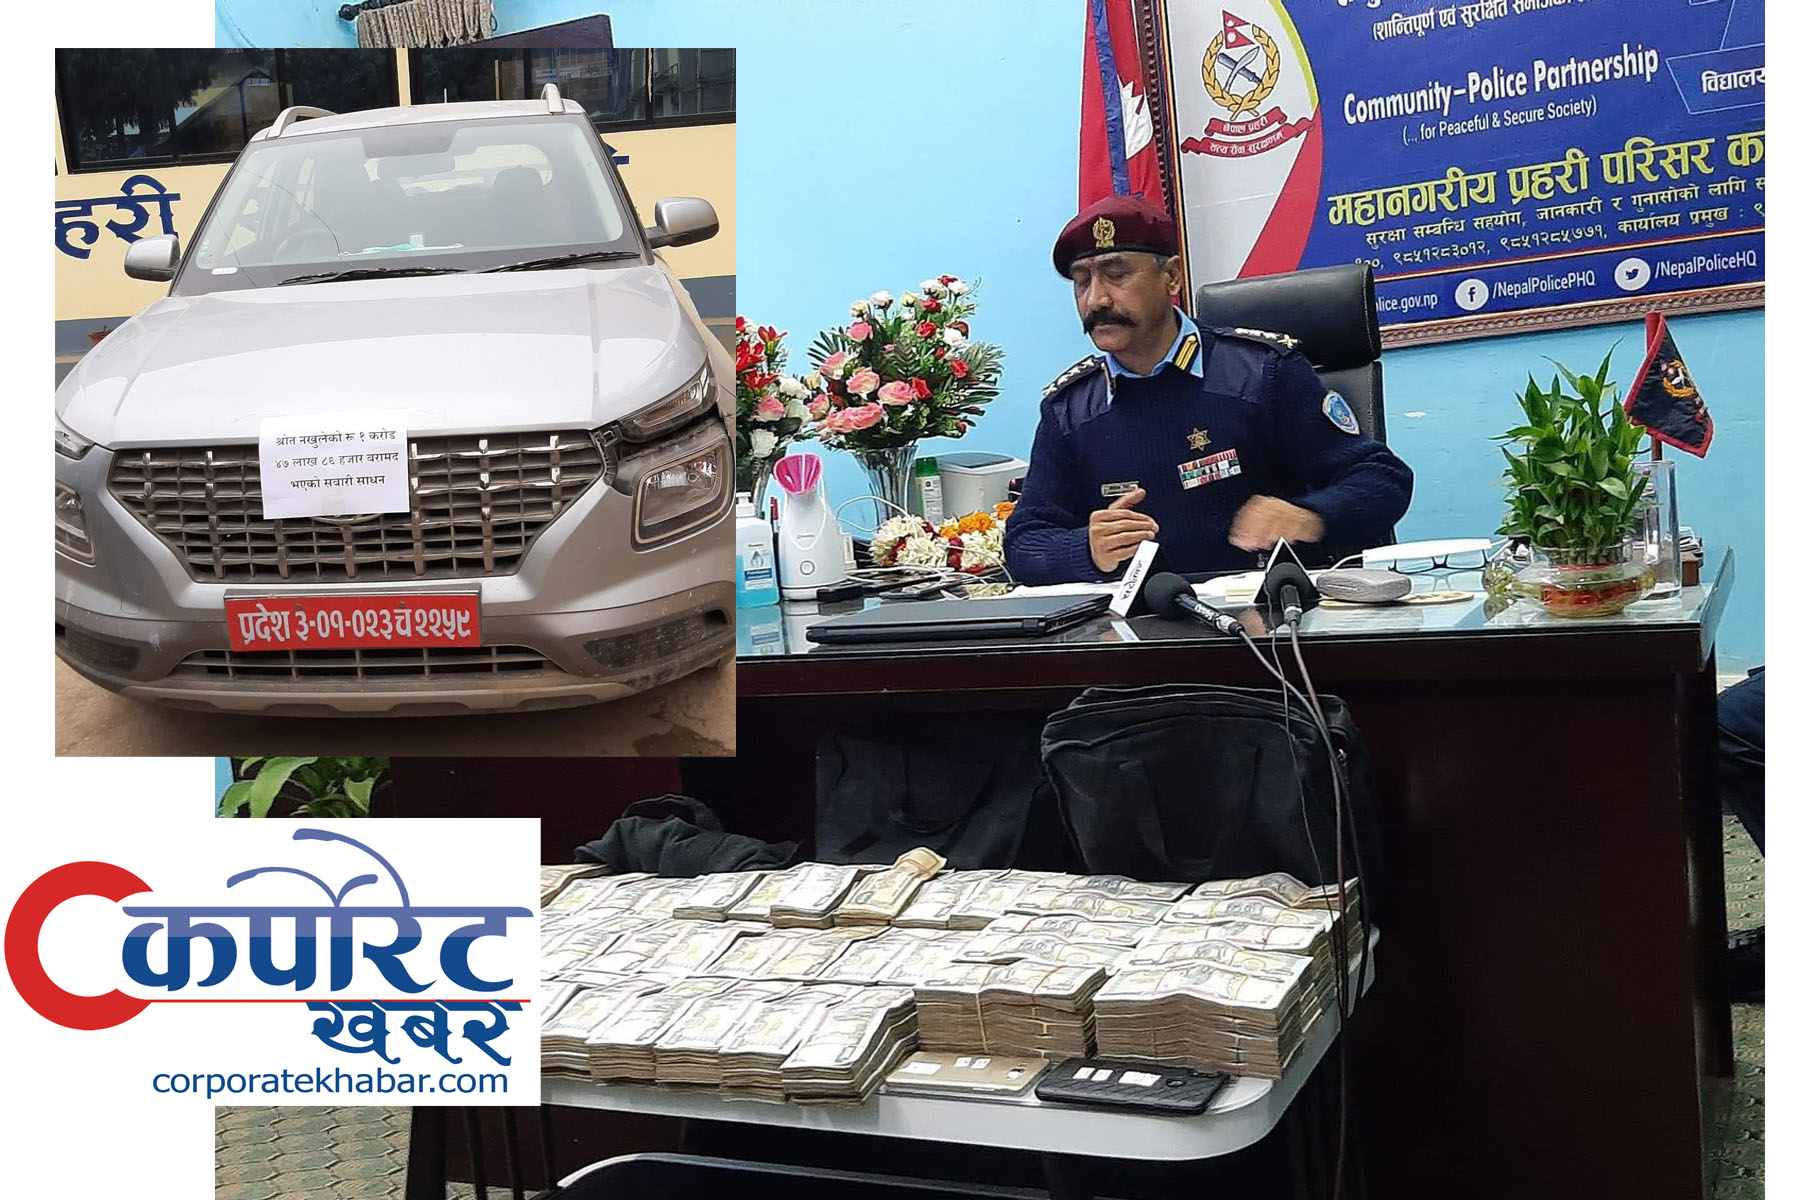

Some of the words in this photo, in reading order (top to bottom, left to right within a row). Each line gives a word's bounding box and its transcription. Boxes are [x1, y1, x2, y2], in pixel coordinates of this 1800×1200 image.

[1439, 4, 1456, 28] एवं
[1533, 43, 1659, 93] Partnership
[1420, 120, 1437, 141] for
[1439, 112, 1490, 137] Peaceful
[1492, 111, 1501, 128] &
[1503, 107, 1545, 127] Secure
[1547, 94, 1598, 120] Society)
[1328, 167, 1497, 226] महानगरीय
[1507, 148, 1590, 205] प्रहरी
[1600, 137, 1716, 185] परिसर
[1366, 227, 1406, 250] सुरक्षा
[1536, 196, 1602, 221] जानकारी
[1611, 197, 1623, 211] र
[1631, 183, 1700, 212] गुनासोको
[1708, 176, 1746, 196] लागि
[1689, 207, 1729, 228] प्रमुख
[1655, 250, 1758, 279] /NepalPoliceHQ
[1492, 270, 1596, 299] /NepalPolicePHQ
[359, 431, 365, 442] १
[369, 427, 396, 440] करोड
[292, 457, 317, 467] लाख
[321, 457, 335, 467] ८६
[338, 454, 364, 465] हजार
[291, 476, 320, 491] भएको
[324, 474, 353, 487] सवारी
[357, 475, 386, 485] साधन
[238, 603, 291, 645] प्रदेश
